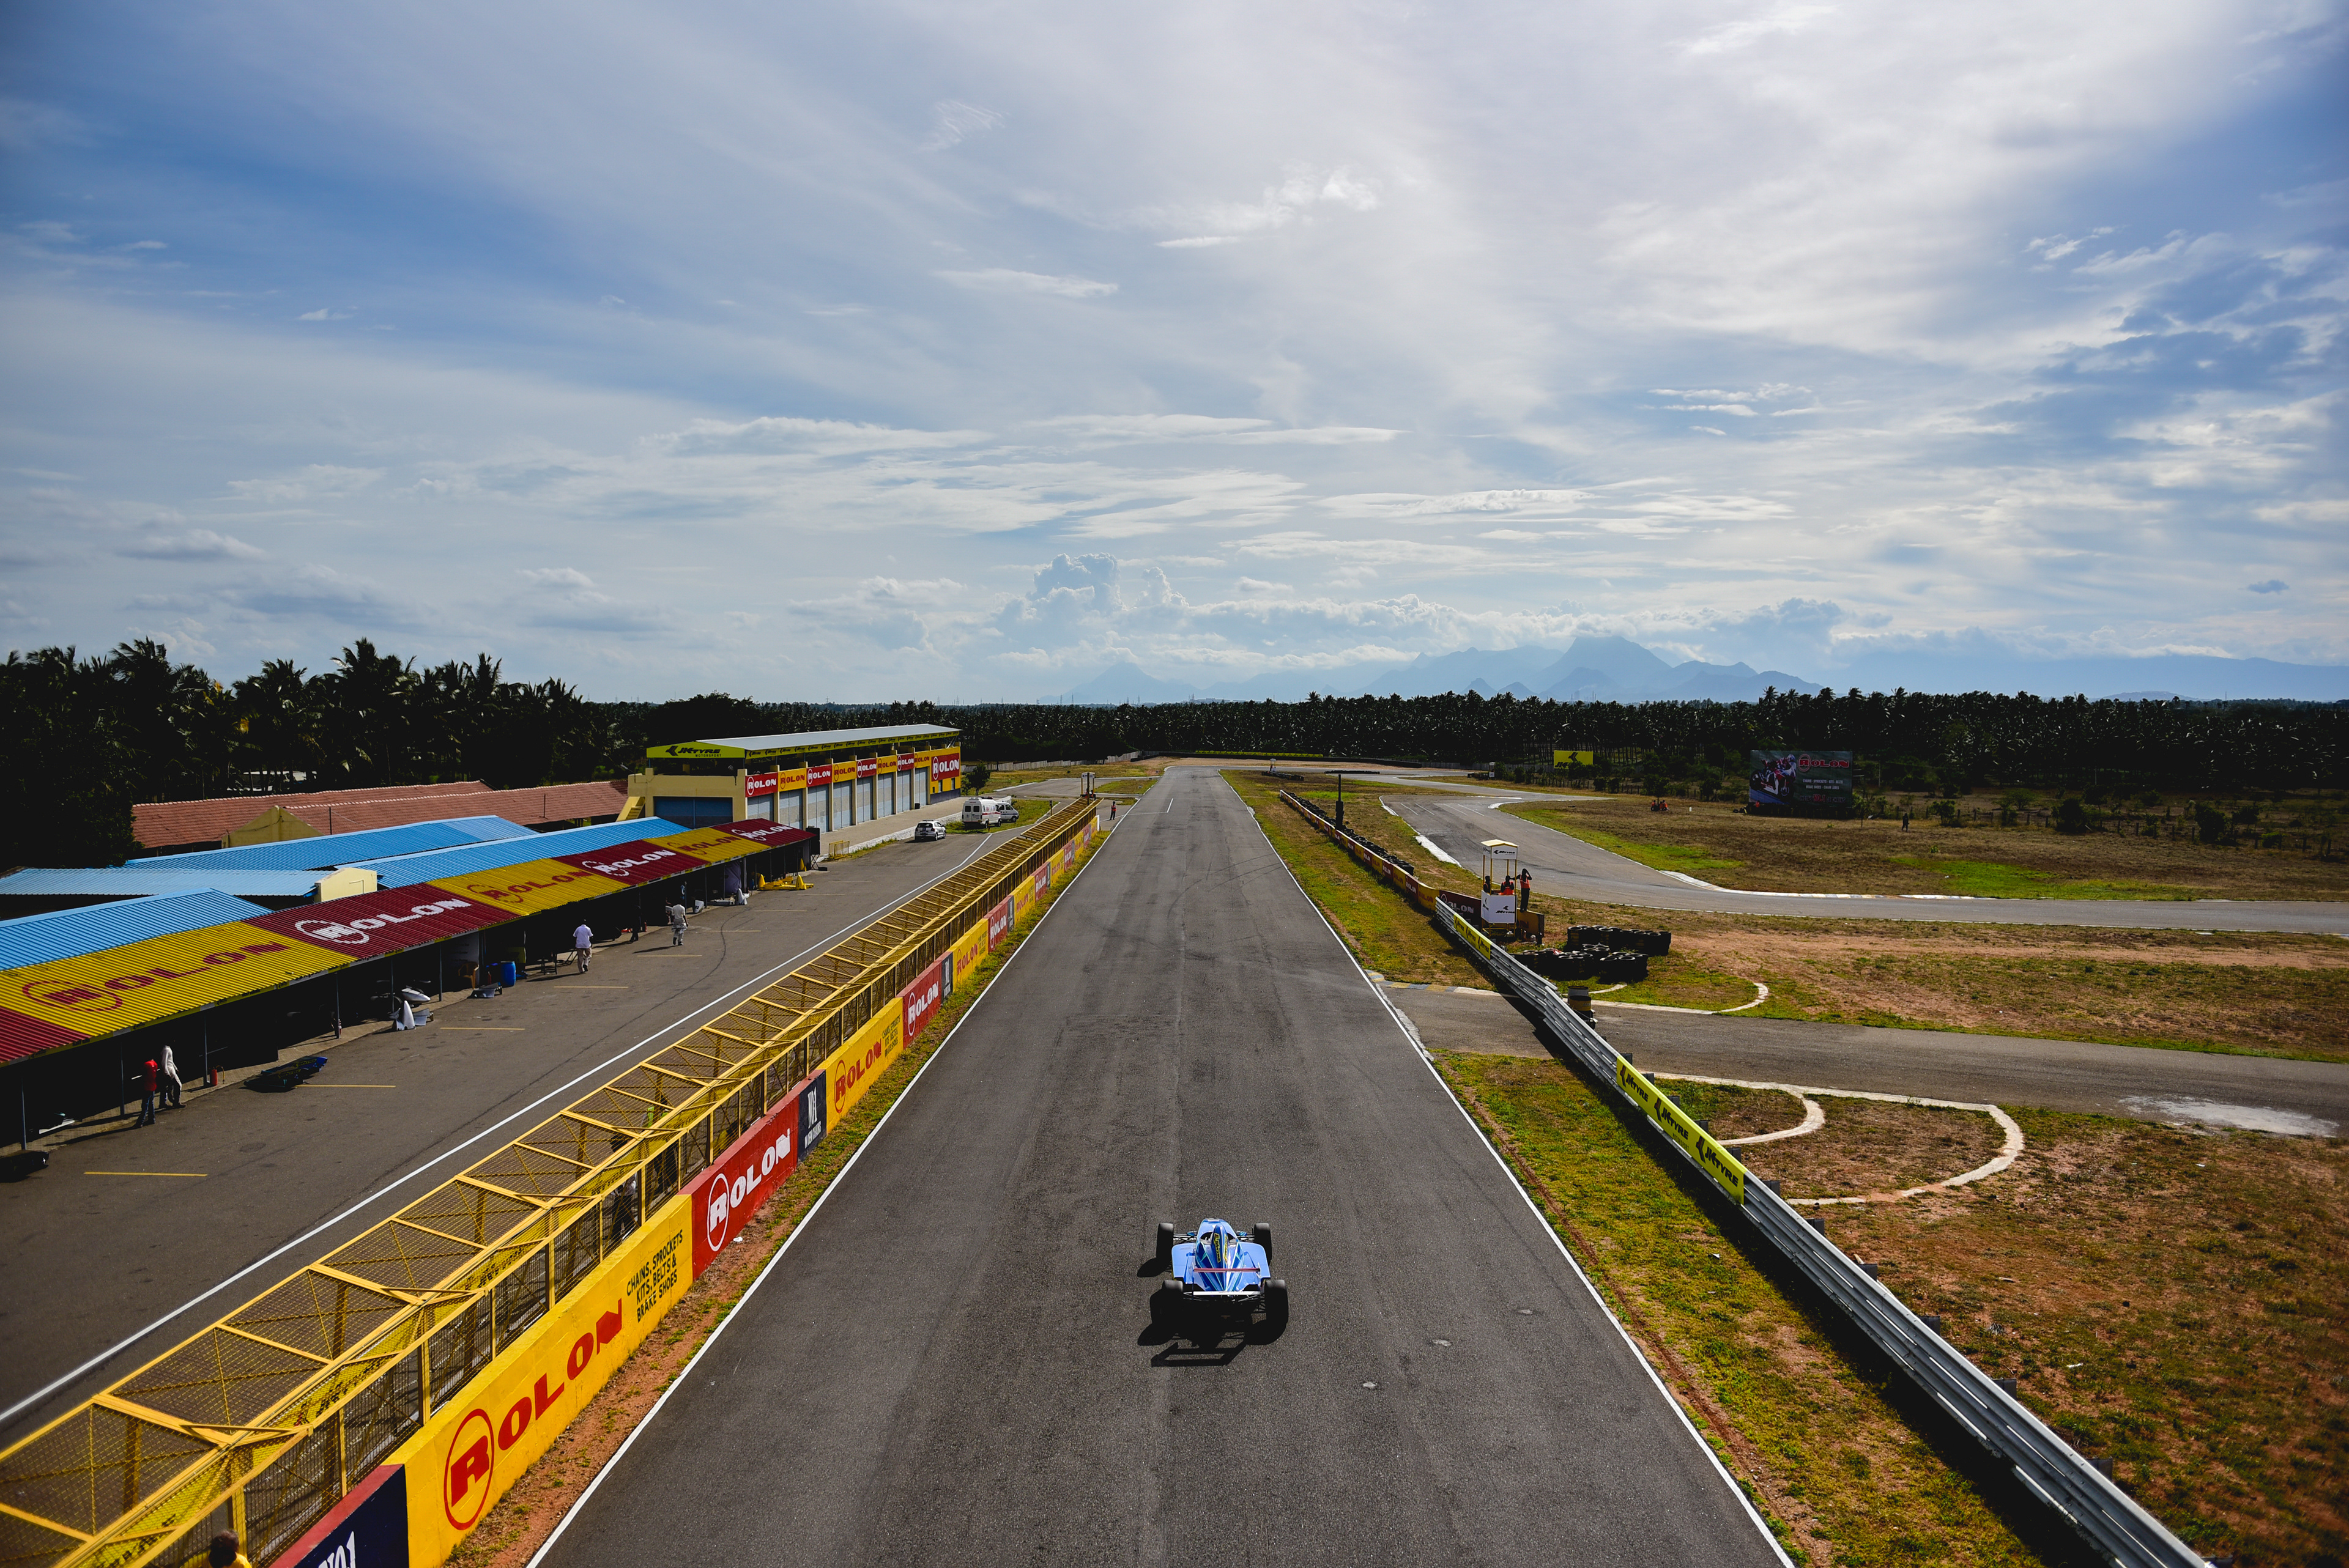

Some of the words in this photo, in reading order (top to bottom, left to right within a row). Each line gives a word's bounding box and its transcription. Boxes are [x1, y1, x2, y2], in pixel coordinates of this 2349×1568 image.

[933, 759, 959, 774] ROLON
[1799, 758, 1849, 768] ROLON
[678, 836, 742, 852] ROLON
[740, 825, 793, 839] ROLON
[592, 849, 676, 873] ROLON
[480, 870, 593, 900] ROLON
[311, 898, 472, 939] ROLON
[990, 914, 1007, 940] ROLON
[42, 941, 289, 1006] ROLON
[957, 944, 978, 976] ROLON
[908, 981, 938, 1025] ROLON
[836, 1038, 882, 1103] ROLON
[710, 1128, 790, 1233] ROLON
[626, 1262, 652, 1296] CHAINS,
[653, 1229, 683, 1270] SPROCKETS
[636, 1279, 652, 1305] KITS,
[653, 1258, 670, 1287] BELTS
[672, 1253, 677, 1268] &
[637, 1290, 657, 1323] BRAKE
[659, 1269, 677, 1298] SHOES
[451, 1298, 623, 1507] ROLON
